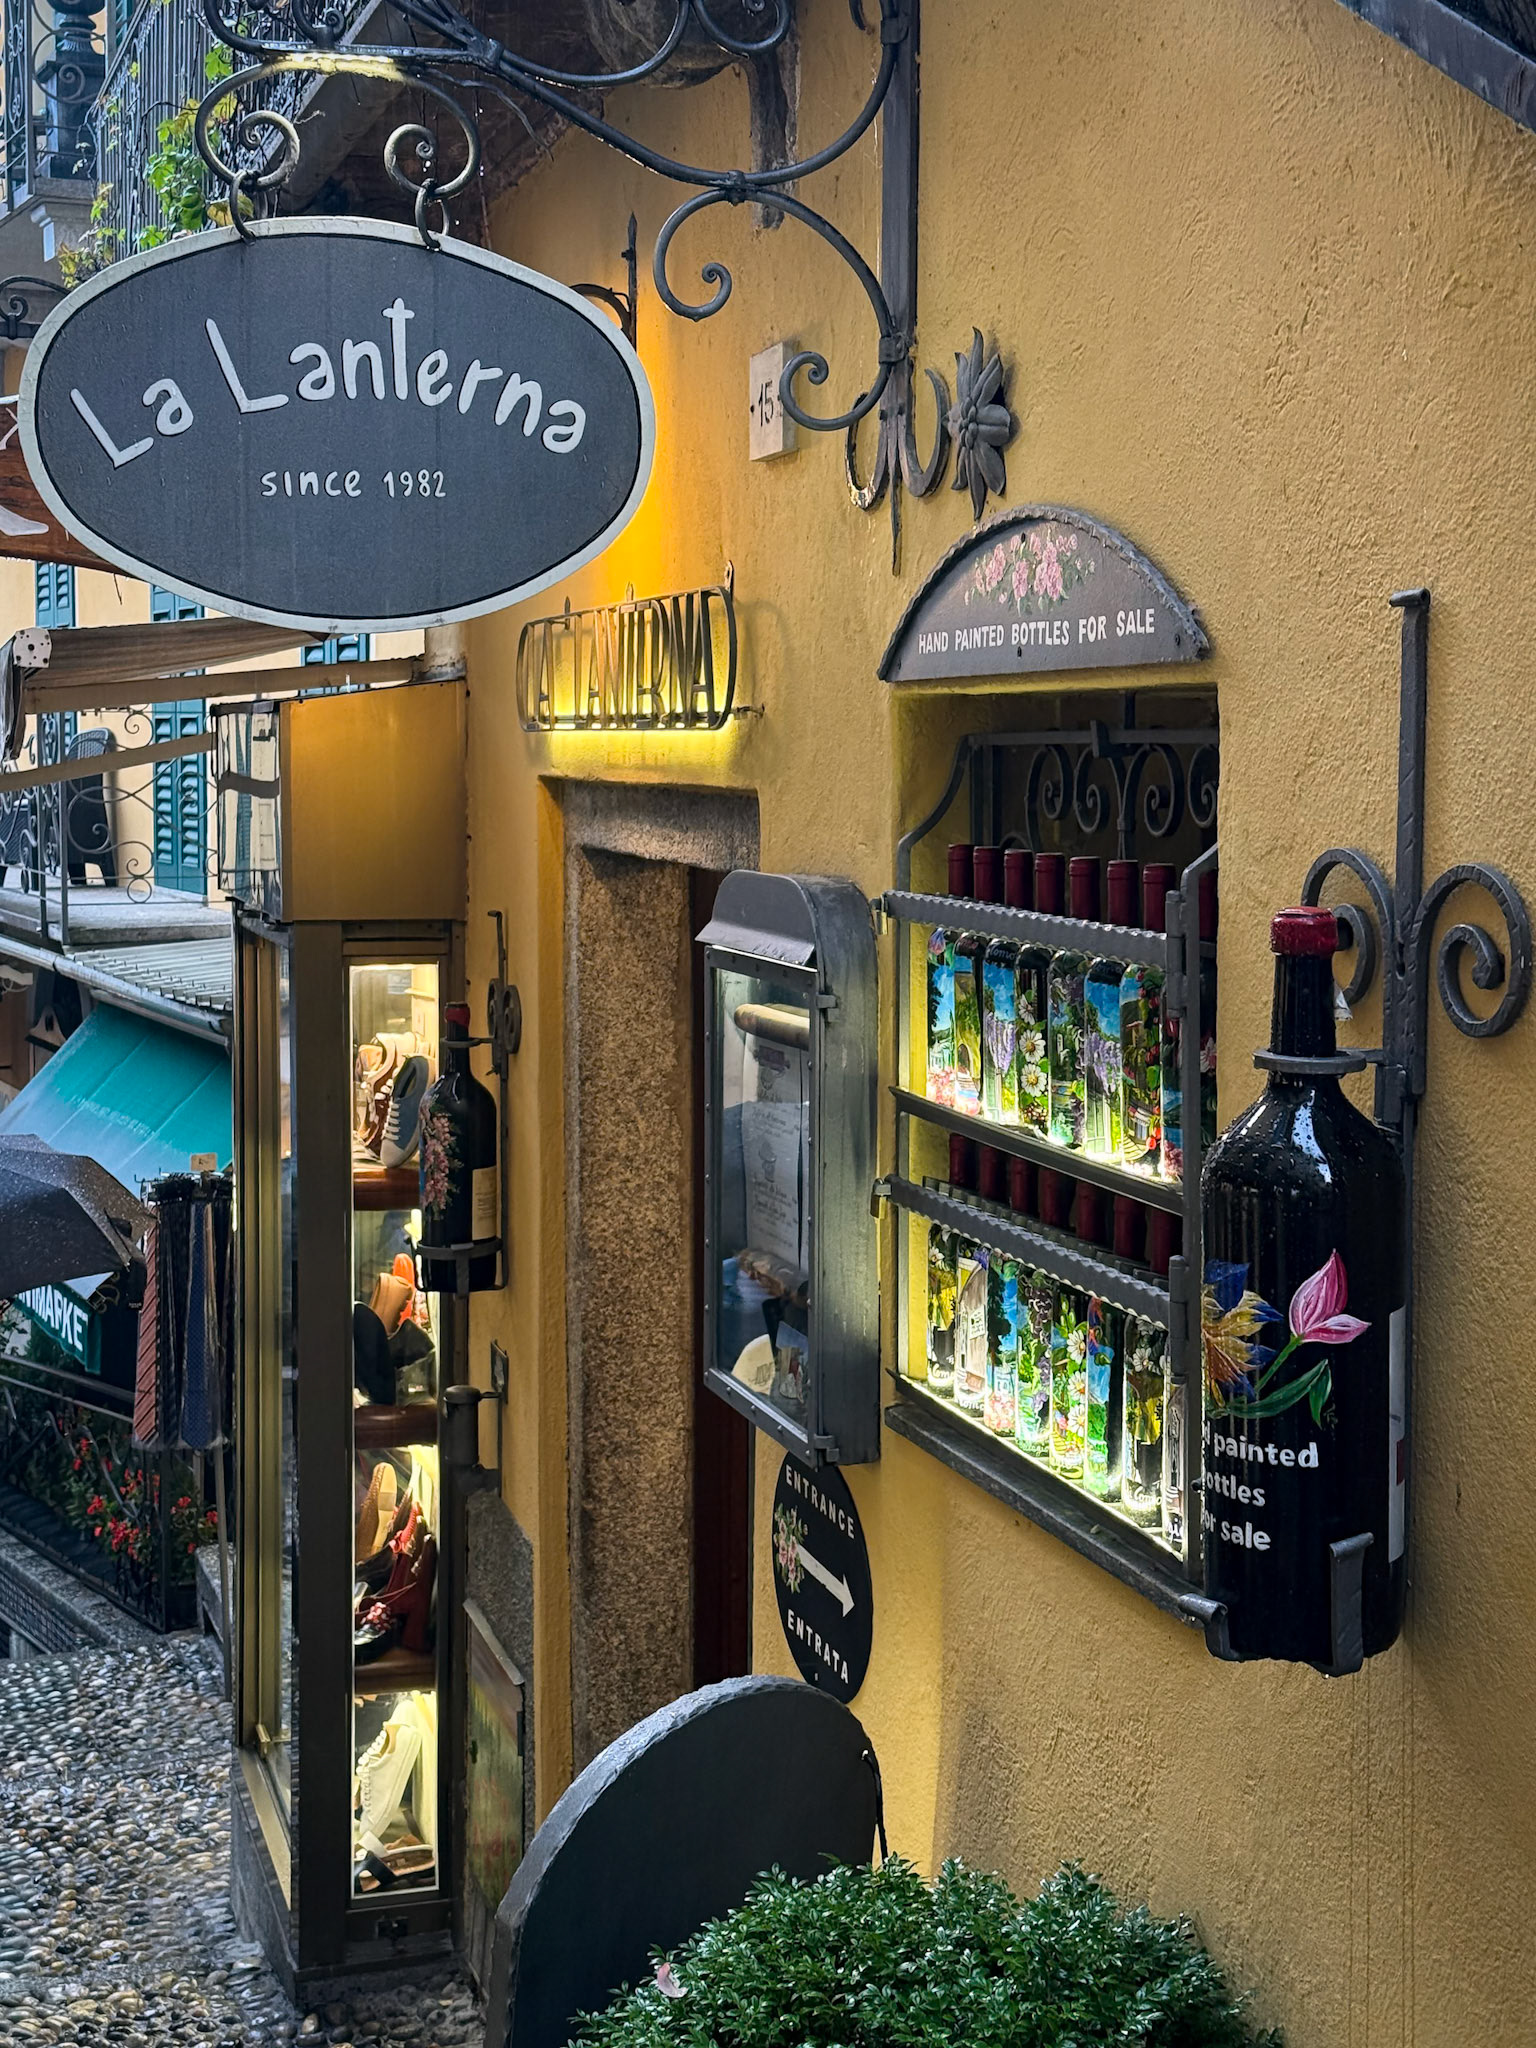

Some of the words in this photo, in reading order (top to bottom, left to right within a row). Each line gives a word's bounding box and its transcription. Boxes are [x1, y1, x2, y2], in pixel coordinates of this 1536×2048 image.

[71, 378, 195, 468] La
[205, 297, 587, 454] Lanterna
[758, 380, 774, 427] 15
[261, 469, 362, 498] since
[383, 470, 447, 498] 1982
[918, 631, 949, 655] HAND
[954, 624, 1004, 651] PAINTED
[1011, 620, 1070, 646] BOTTLES
[1078, 616, 1107, 644] FOR
[1116, 608, 1155, 637] SALE
[1214, 1432, 1320, 1468] painted
[786, 1464, 855, 1540] ENTRANCE
[1206, 1471, 1266, 1507] ottles
[1220, 1520, 1272, 1551] sale
[787, 1608, 849, 1685] ENTRATA
